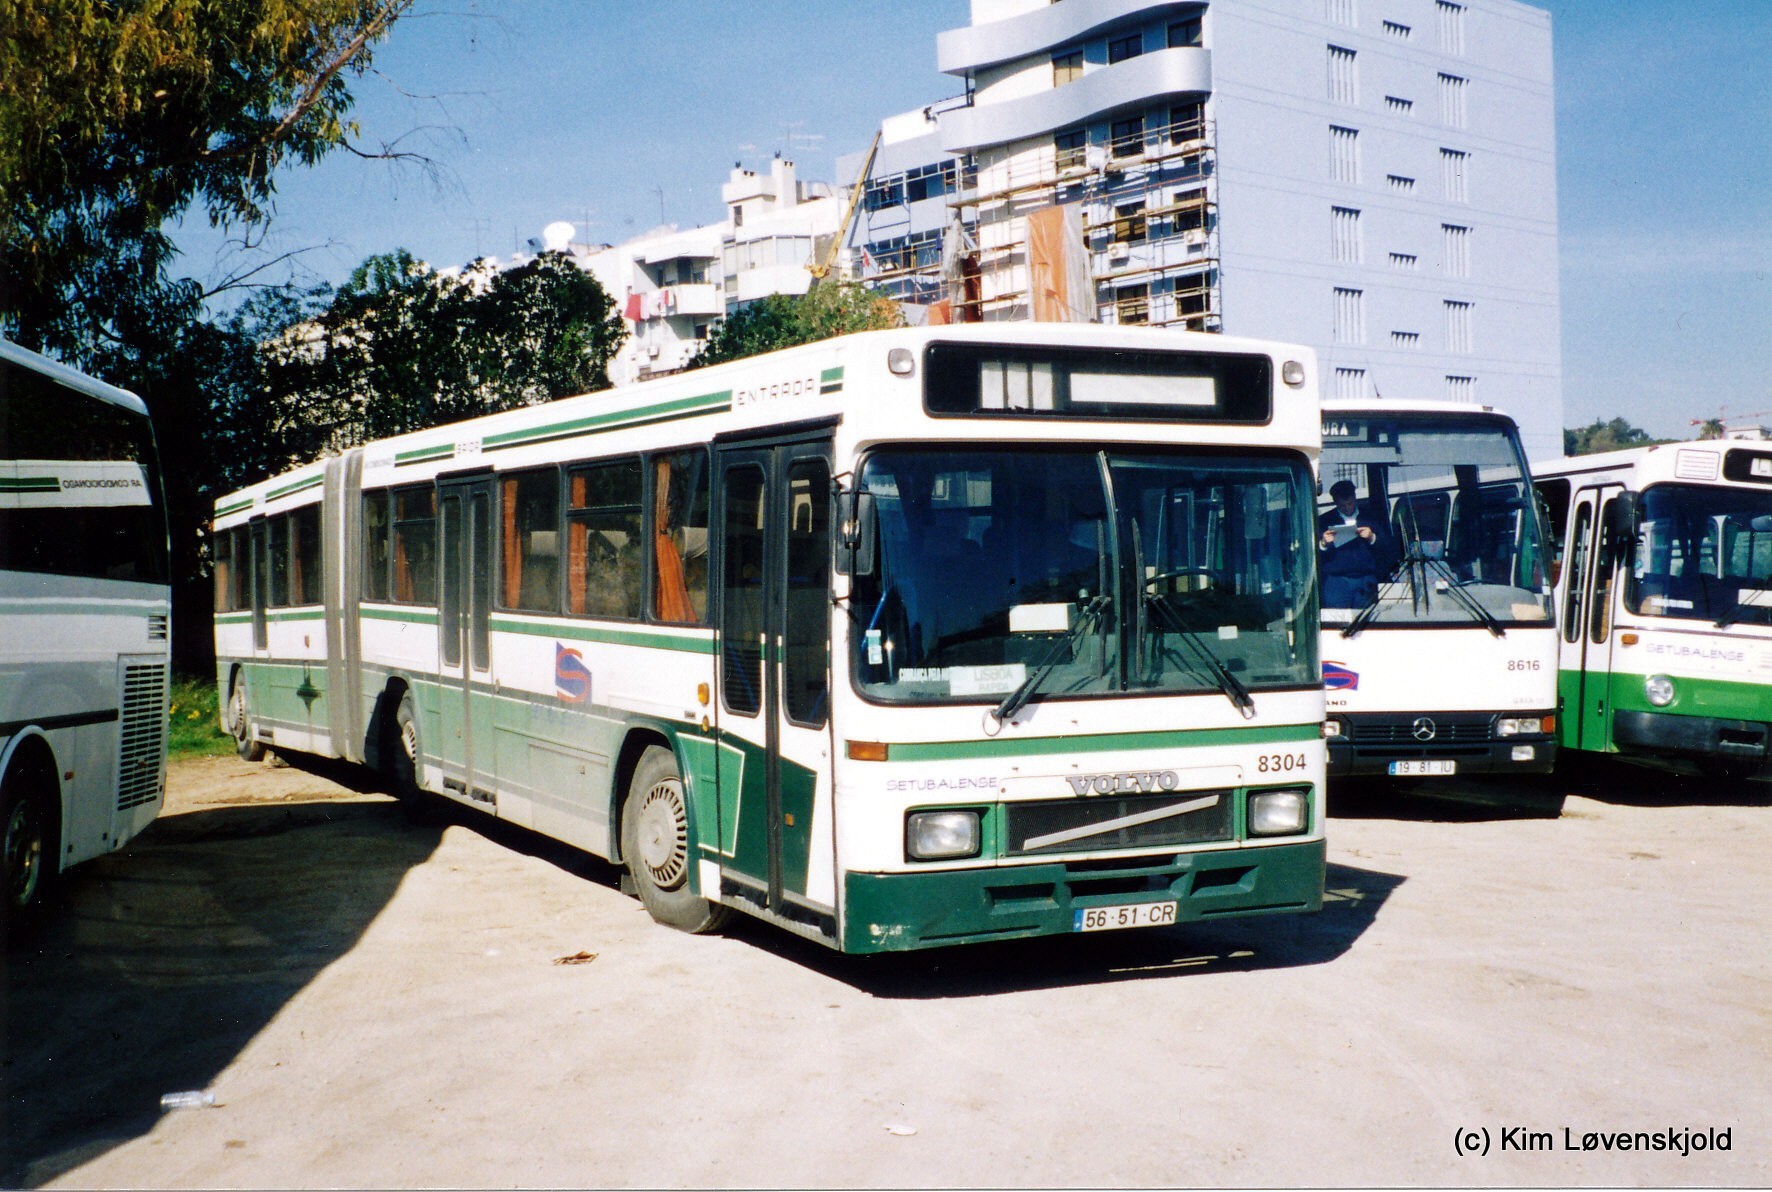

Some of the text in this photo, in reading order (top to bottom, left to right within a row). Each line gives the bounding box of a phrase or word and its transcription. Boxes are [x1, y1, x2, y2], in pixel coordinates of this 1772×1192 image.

[738, 378, 815, 406] ENTRADA
[1646, 643, 1744, 661] SETUBALENSE
[975, 667, 1013, 681] LISBOA
[1507, 659, 1541, 671] 8616
[1258, 753, 1306, 773] 8304
[886, 776, 998, 791] SETUBALENSE
[1065, 771, 1180, 797] VOLVO
